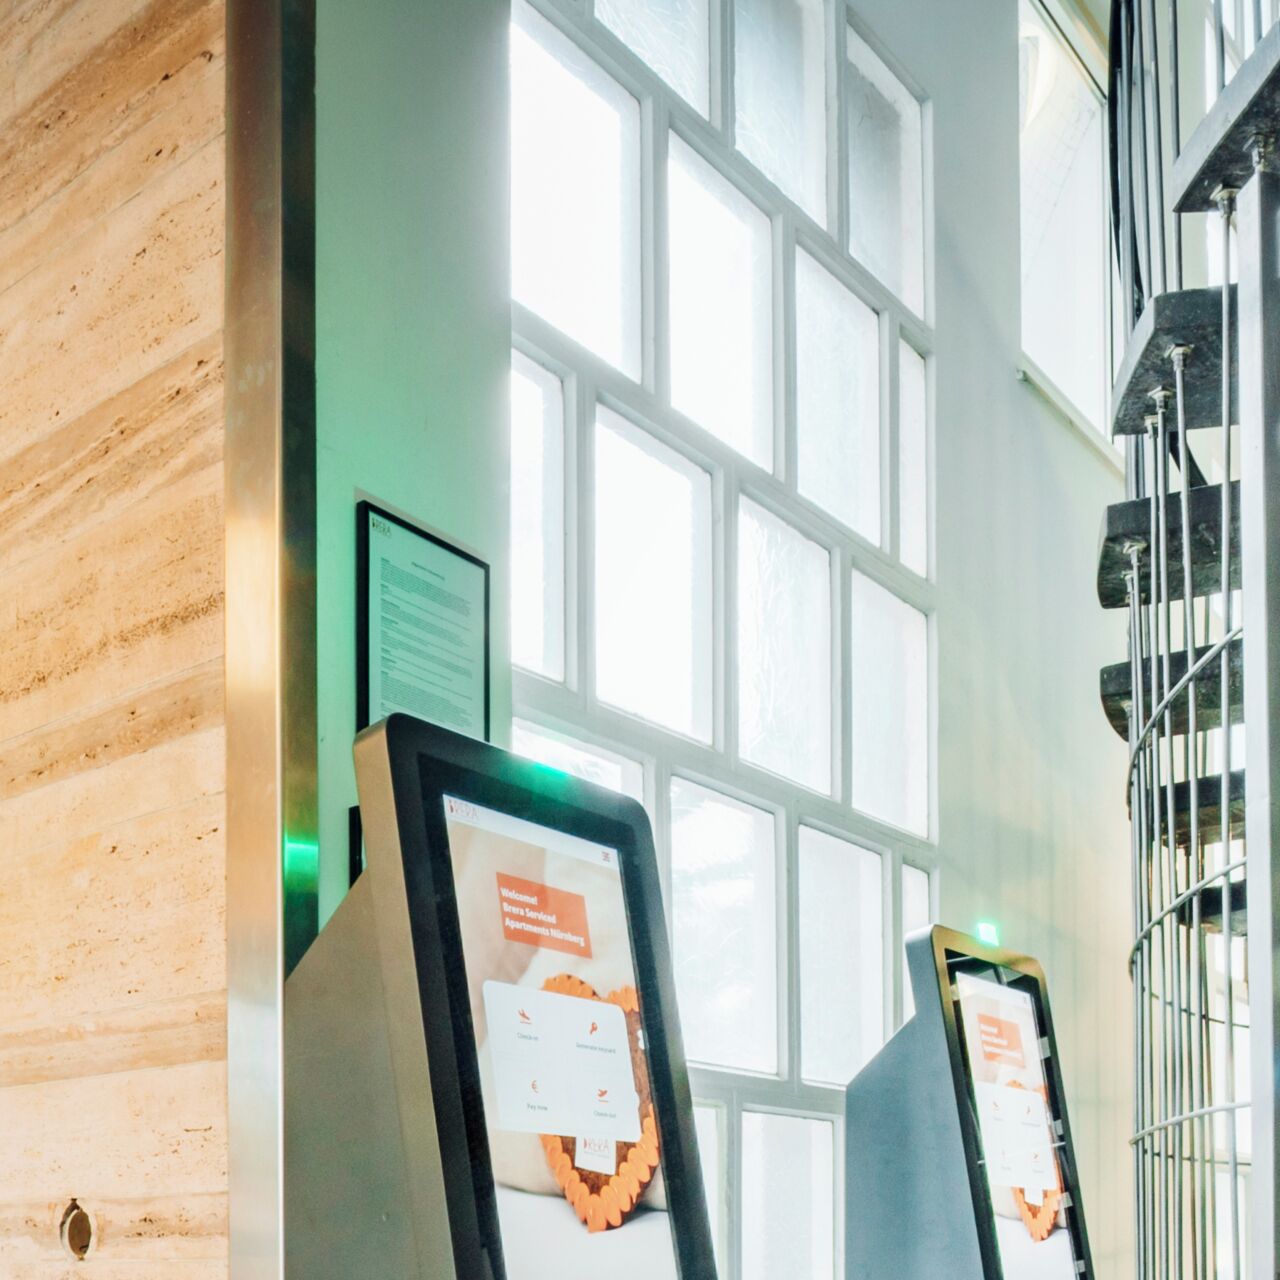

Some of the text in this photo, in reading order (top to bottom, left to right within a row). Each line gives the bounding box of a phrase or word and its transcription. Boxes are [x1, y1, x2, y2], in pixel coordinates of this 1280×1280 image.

[500, 887, 538, 905] Welcome!
[503, 902, 557, 924] Brera Serviced
[505, 917, 550, 936] Apartments
